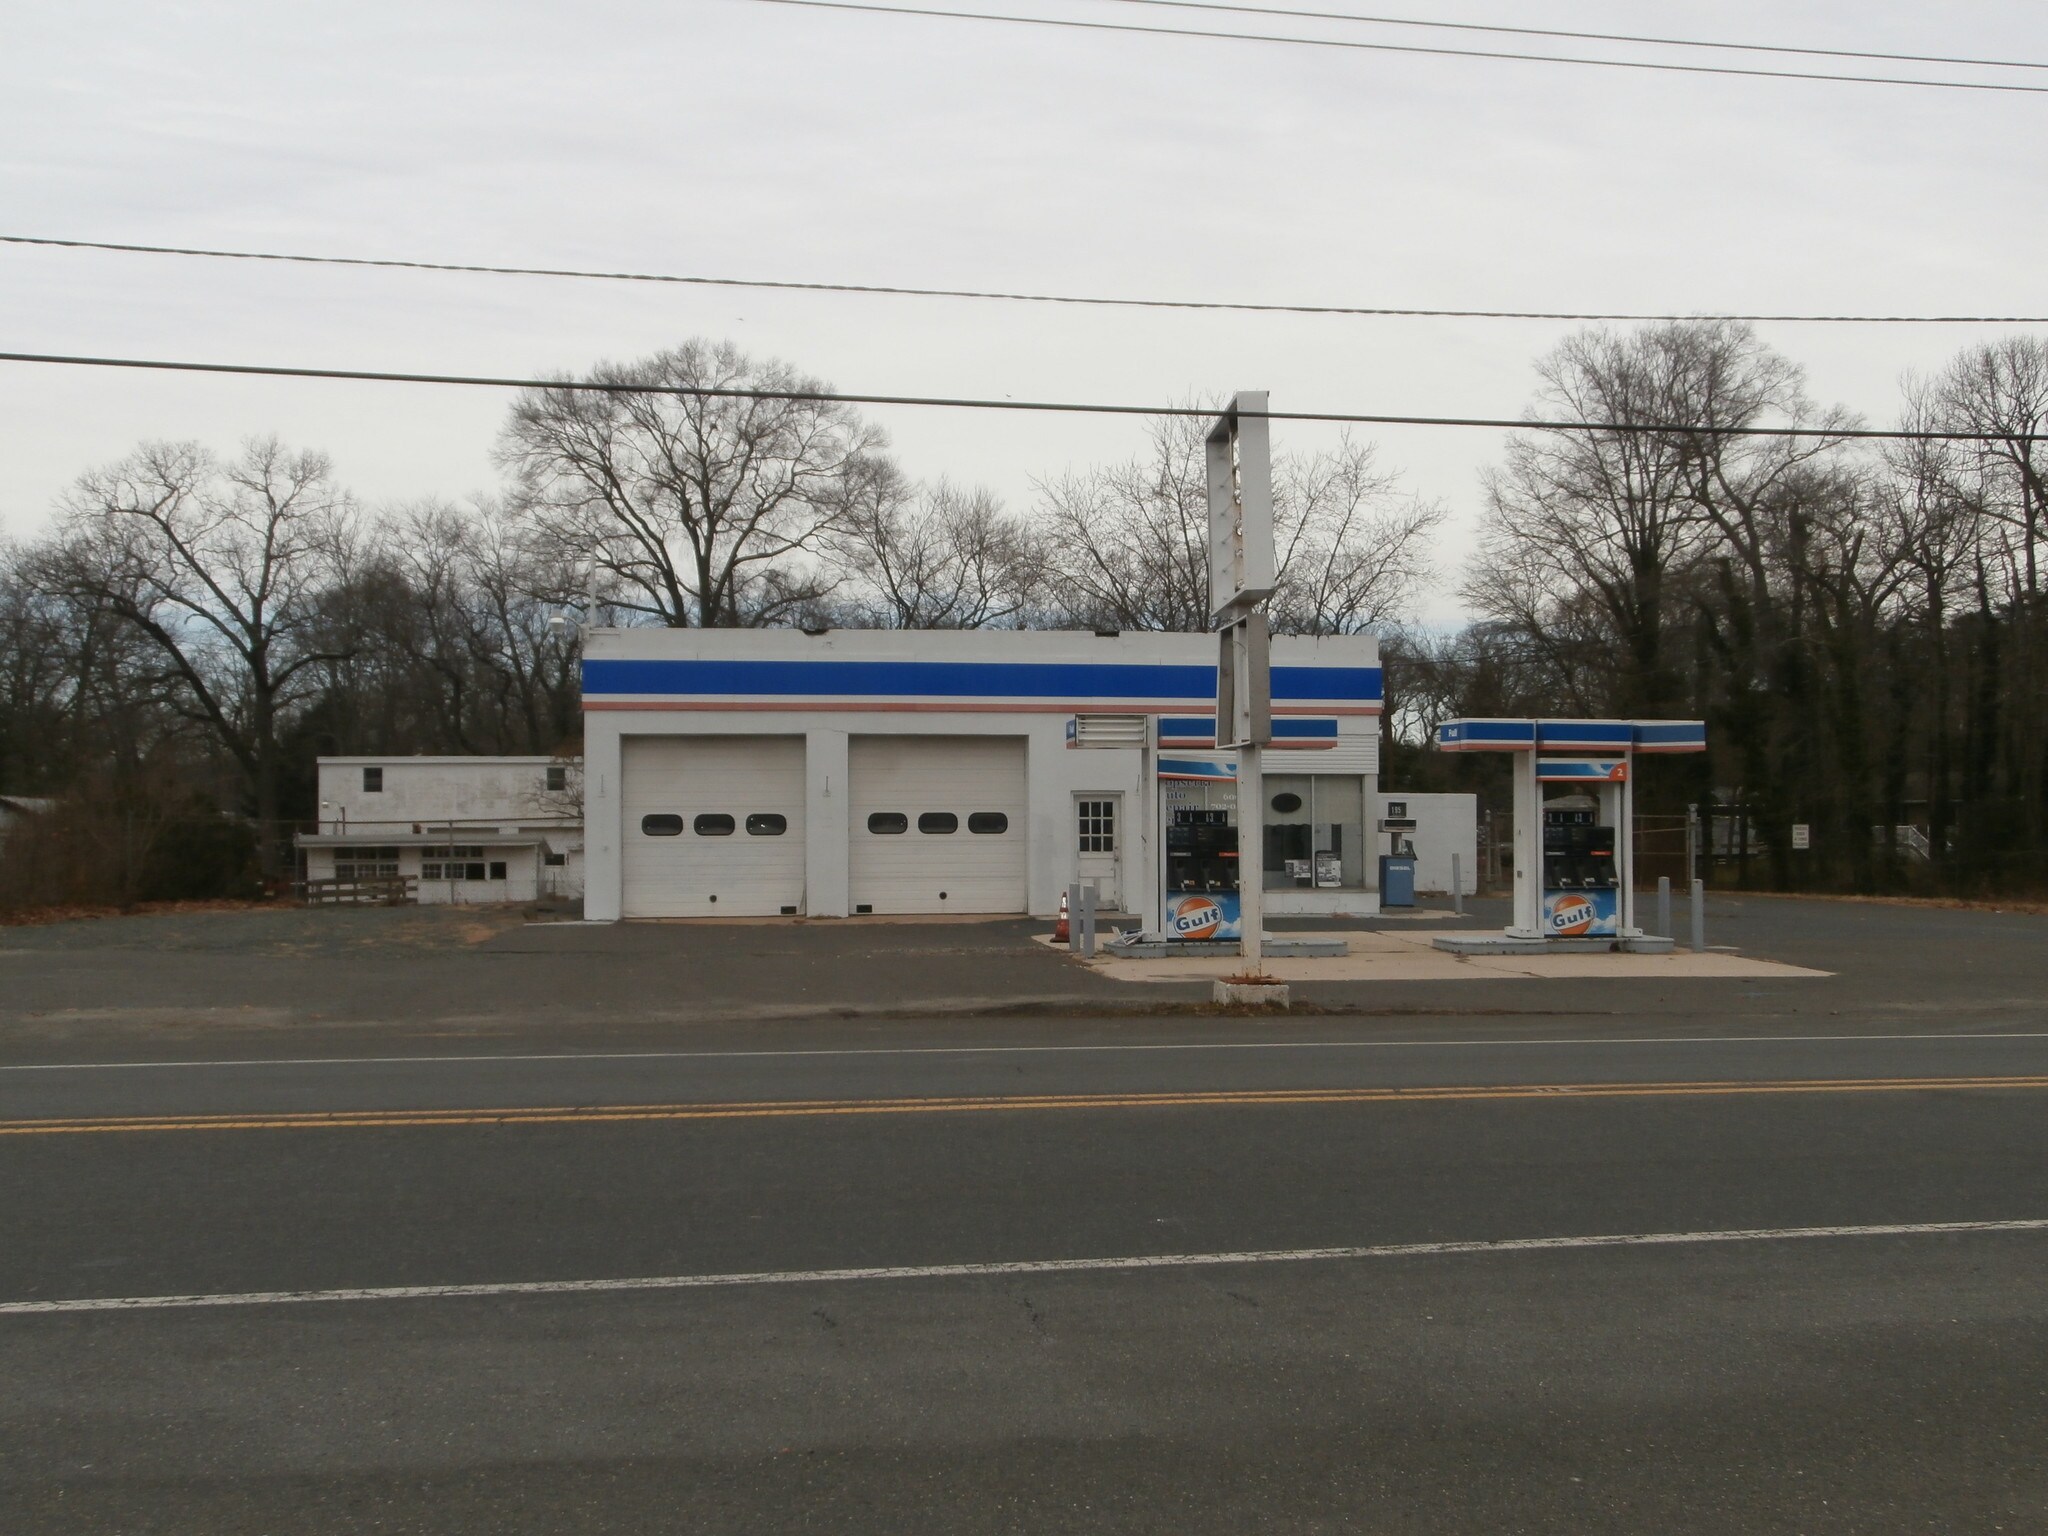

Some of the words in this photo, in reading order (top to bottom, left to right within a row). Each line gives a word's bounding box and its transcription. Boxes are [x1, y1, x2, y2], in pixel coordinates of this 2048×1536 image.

[1617, 768, 1624, 776] 2
[1166, 791, 1186, 799] uto
[1175, 908, 1219, 930] Gulf
[1553, 906, 1592, 928] Gulf
